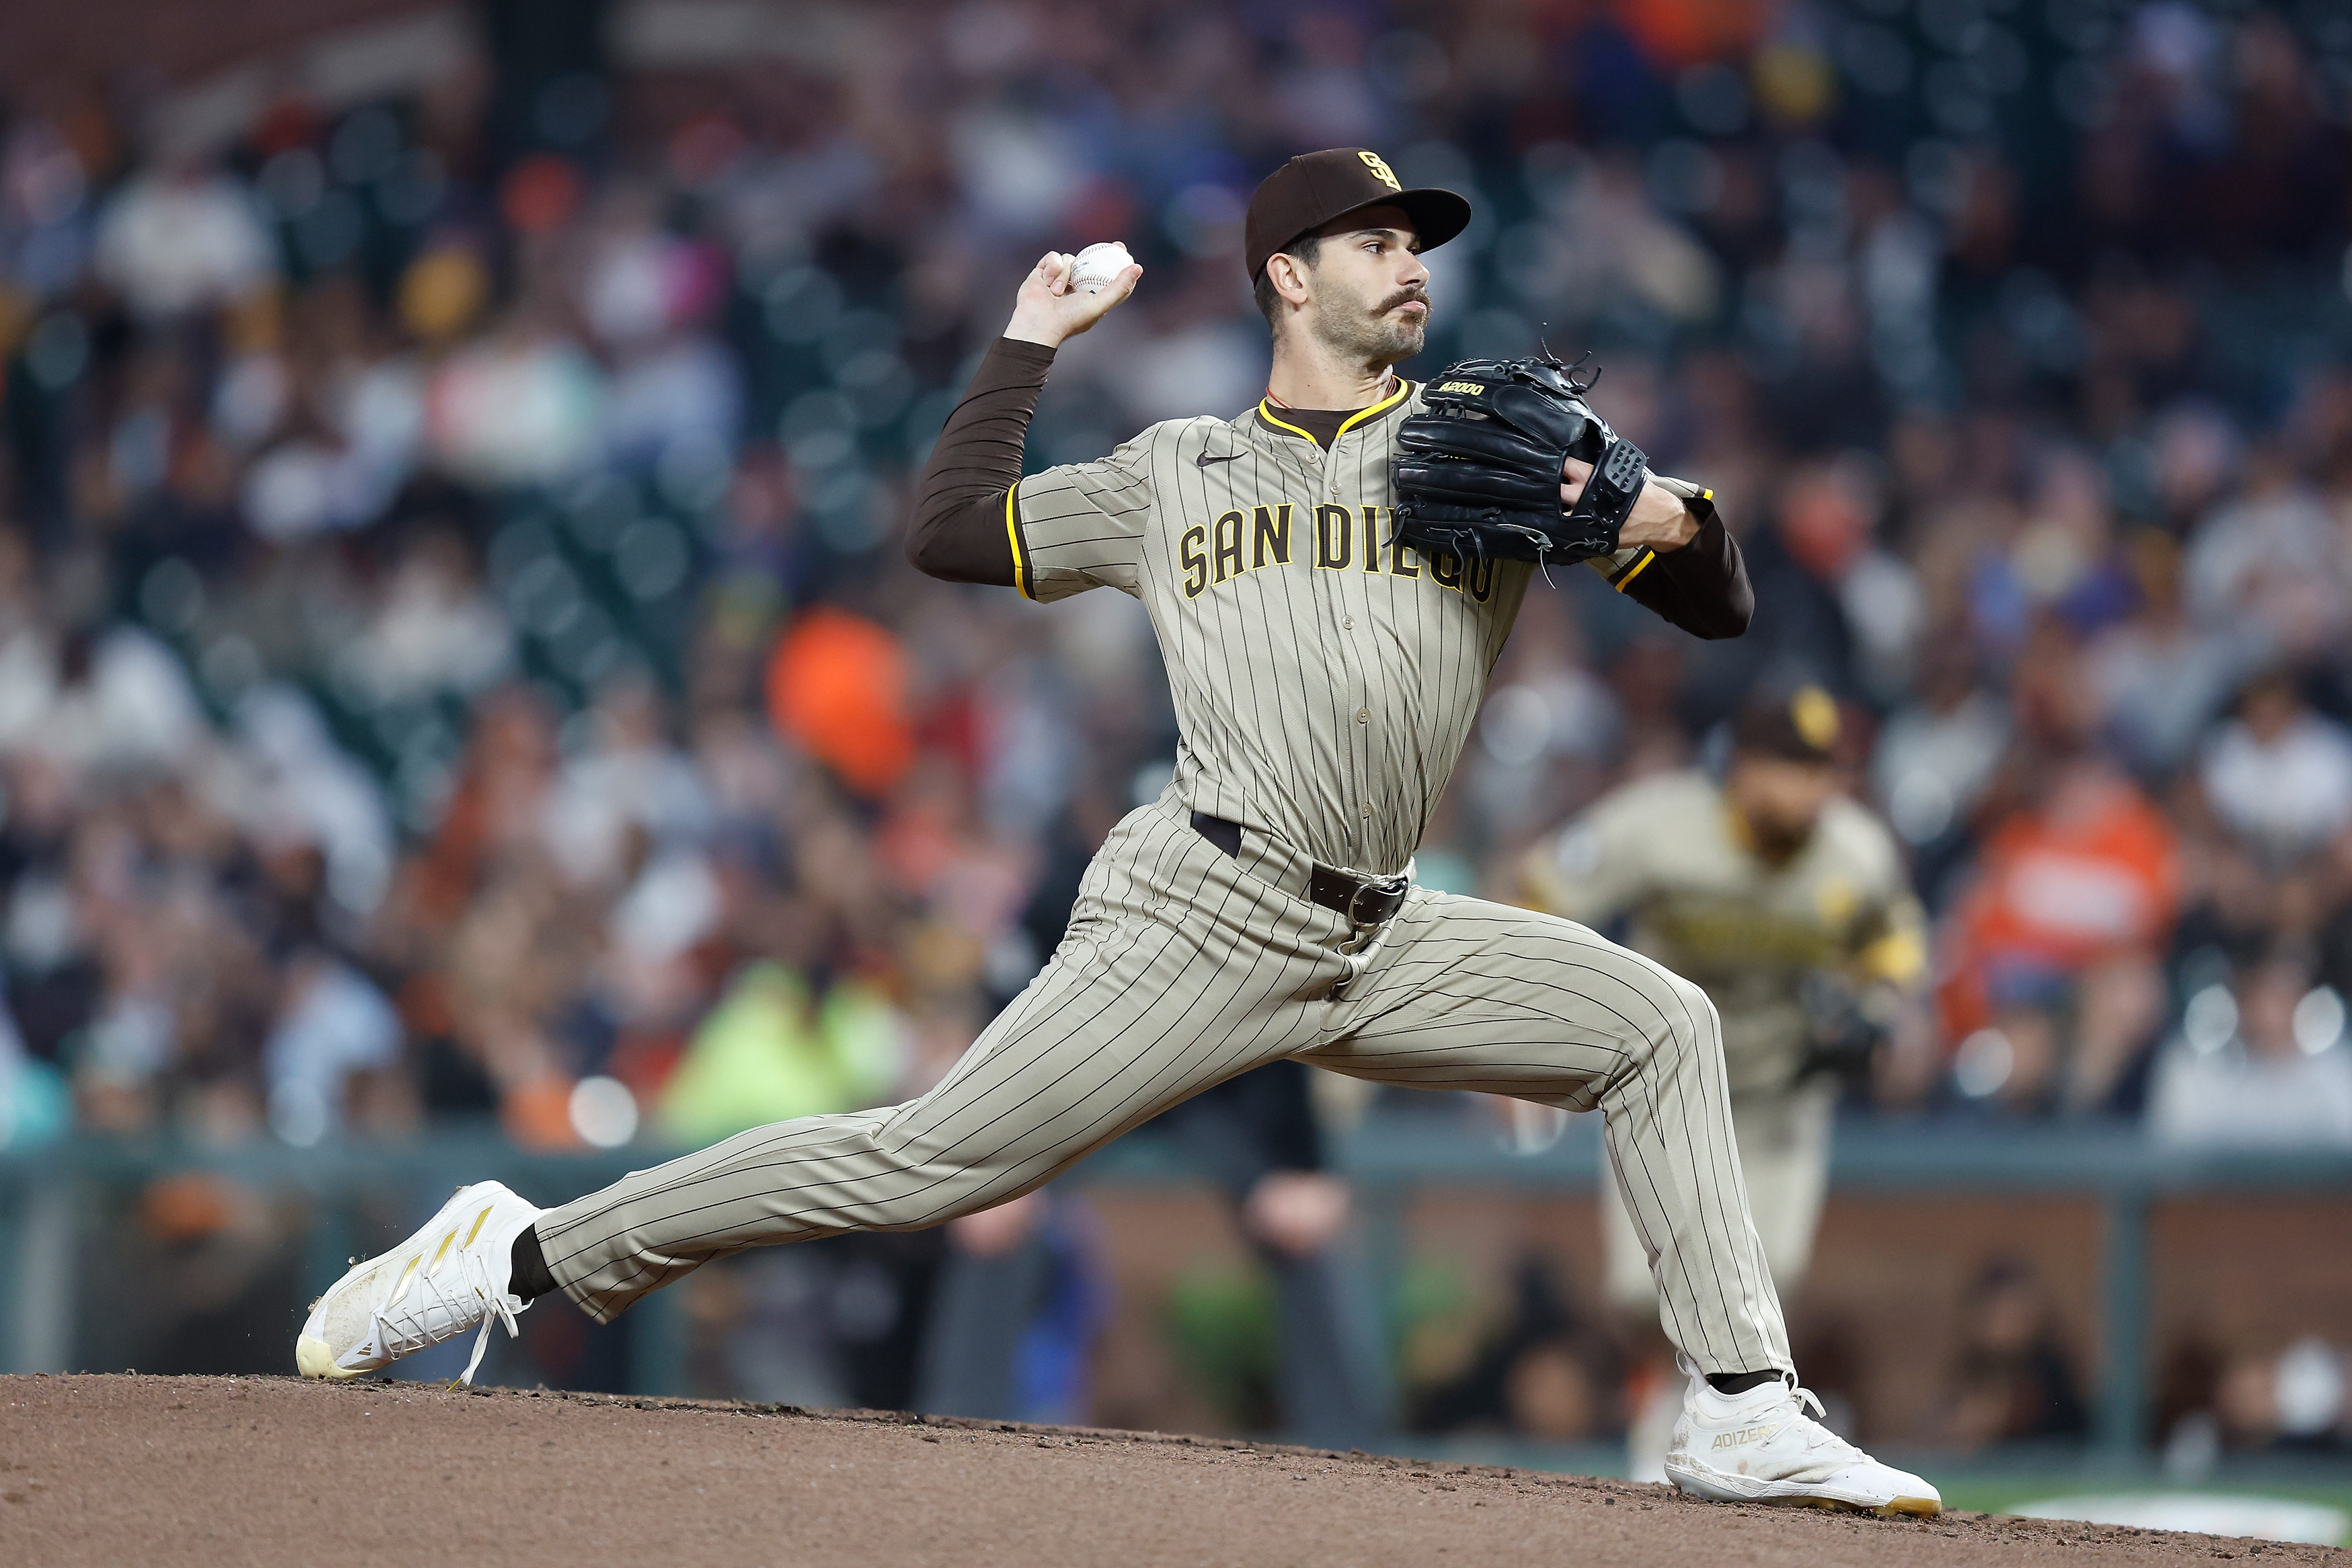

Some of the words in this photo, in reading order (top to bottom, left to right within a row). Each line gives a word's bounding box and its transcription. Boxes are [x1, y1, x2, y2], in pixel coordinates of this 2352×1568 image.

[1358, 151, 1402, 191] SD
[1438, 381, 1485, 396] A2000
[1179, 502, 1296, 601] SAN
